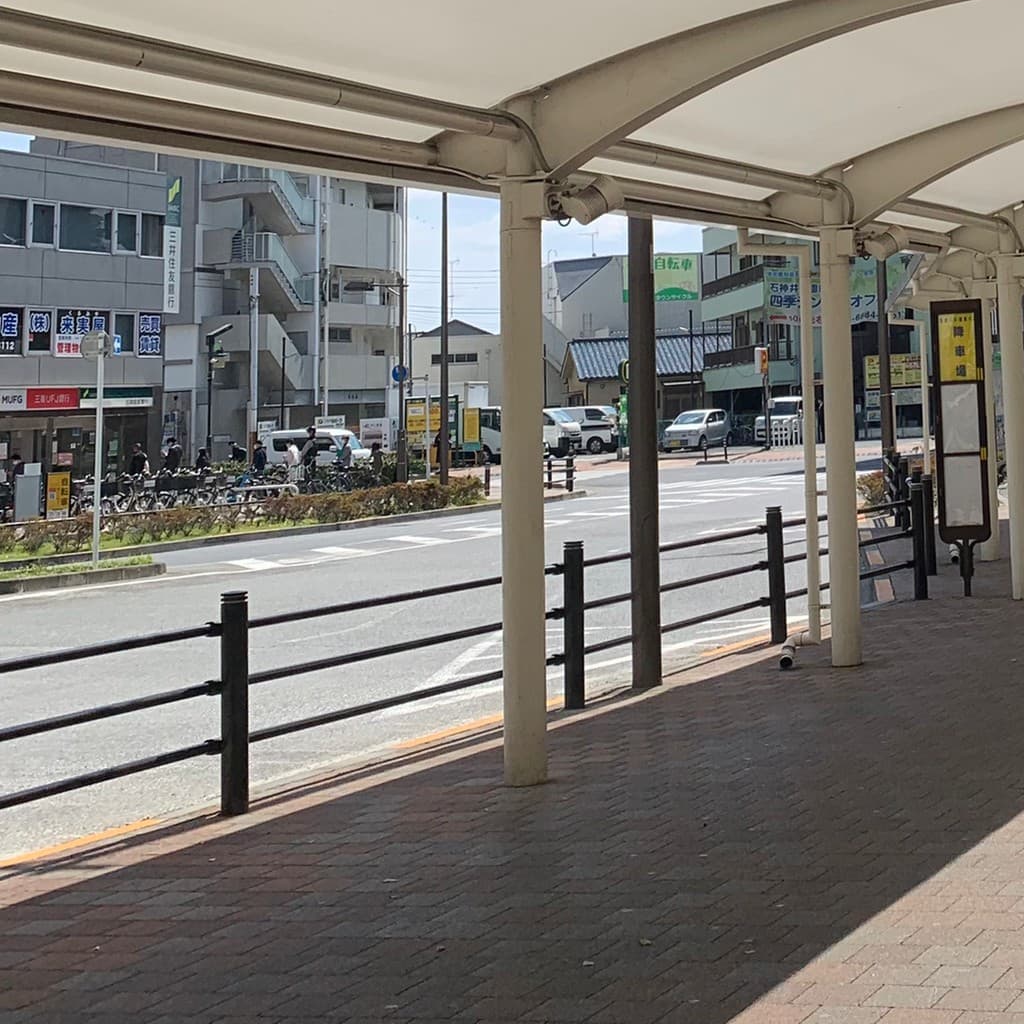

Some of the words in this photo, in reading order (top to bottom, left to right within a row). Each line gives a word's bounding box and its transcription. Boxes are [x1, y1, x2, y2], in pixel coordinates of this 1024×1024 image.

[168, 230, 177, 309] 三井住友銀行
[0, 312, 18, 336] 産
[57, 342, 80, 354] 管理物
[2, 395, 23, 404] MUFG
